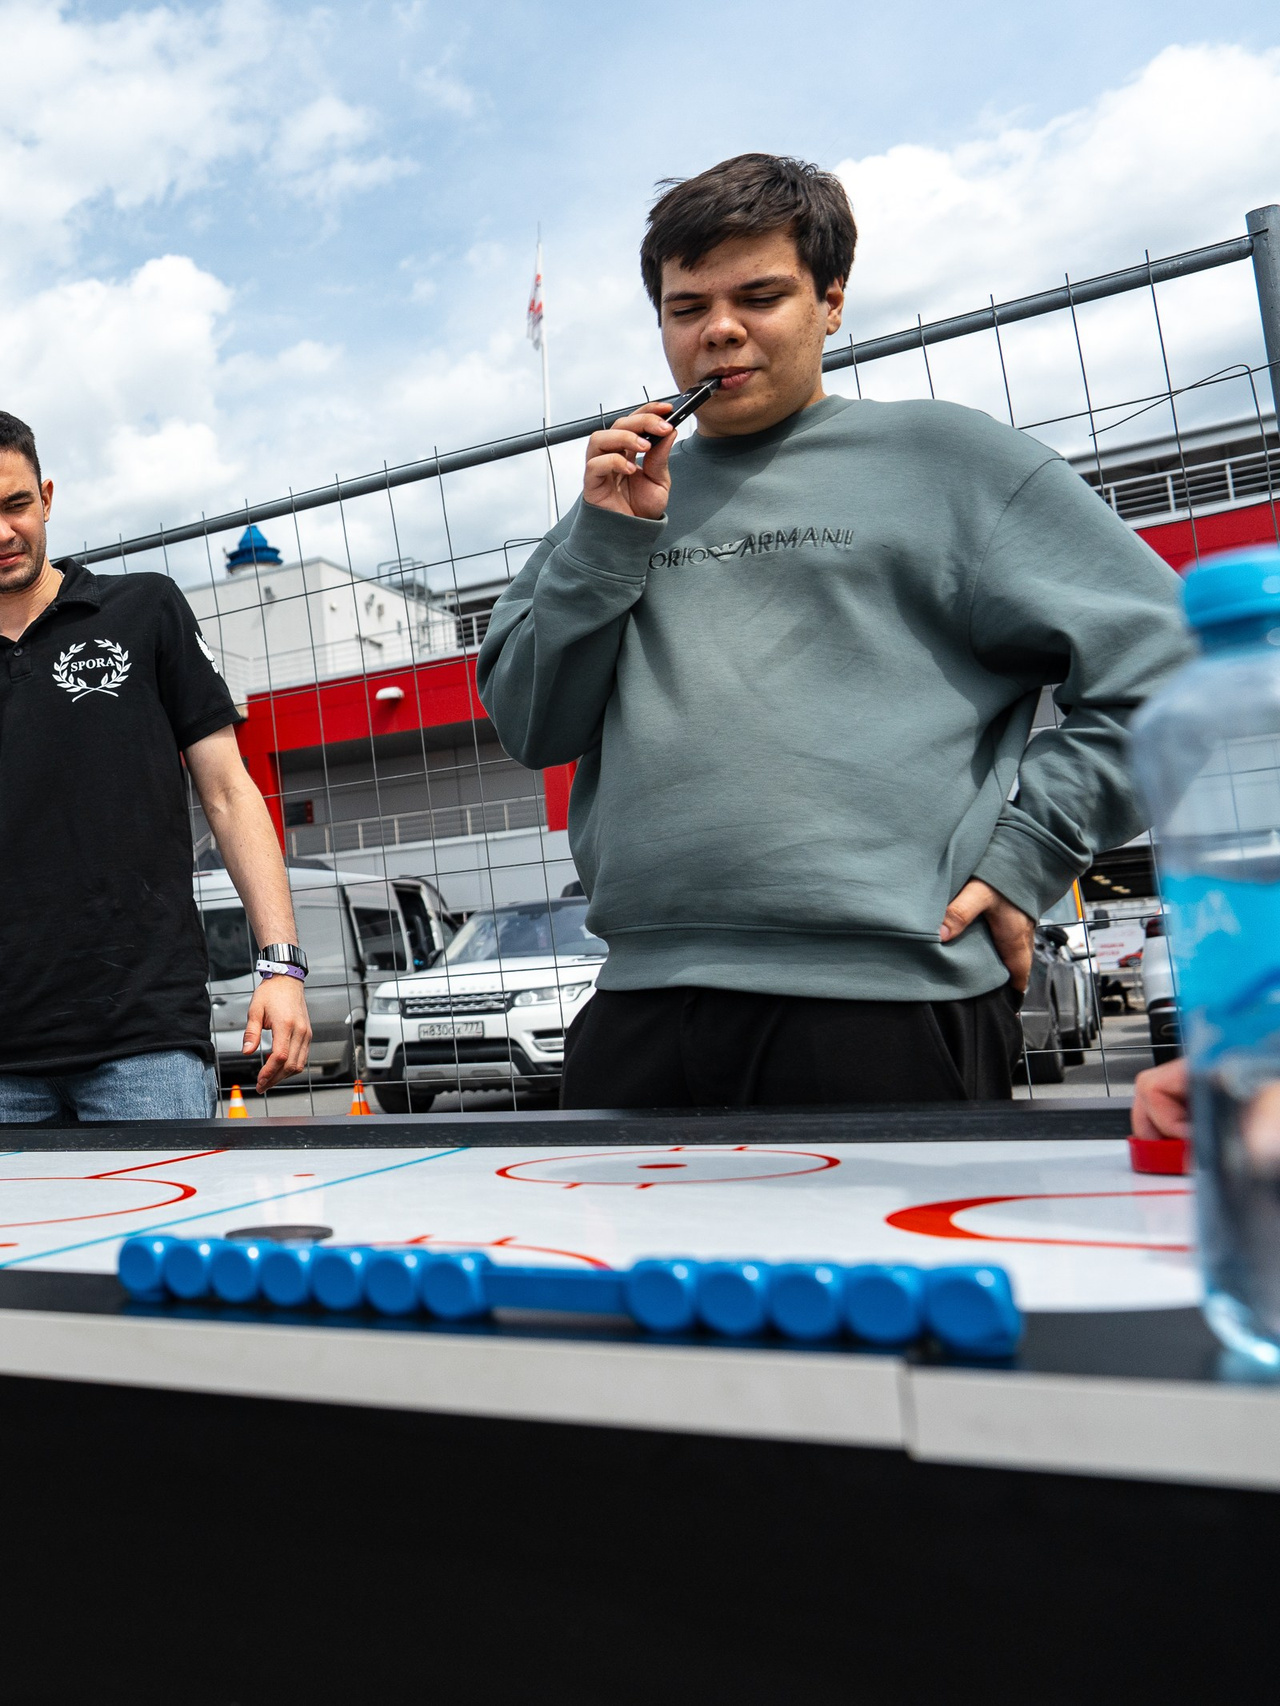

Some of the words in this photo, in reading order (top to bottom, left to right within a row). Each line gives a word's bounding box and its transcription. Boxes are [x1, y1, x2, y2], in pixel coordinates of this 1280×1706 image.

[649, 547, 709, 569] ORIO
[739, 526, 854, 557] ARMANI
[70, 657, 115, 672] SPORA
